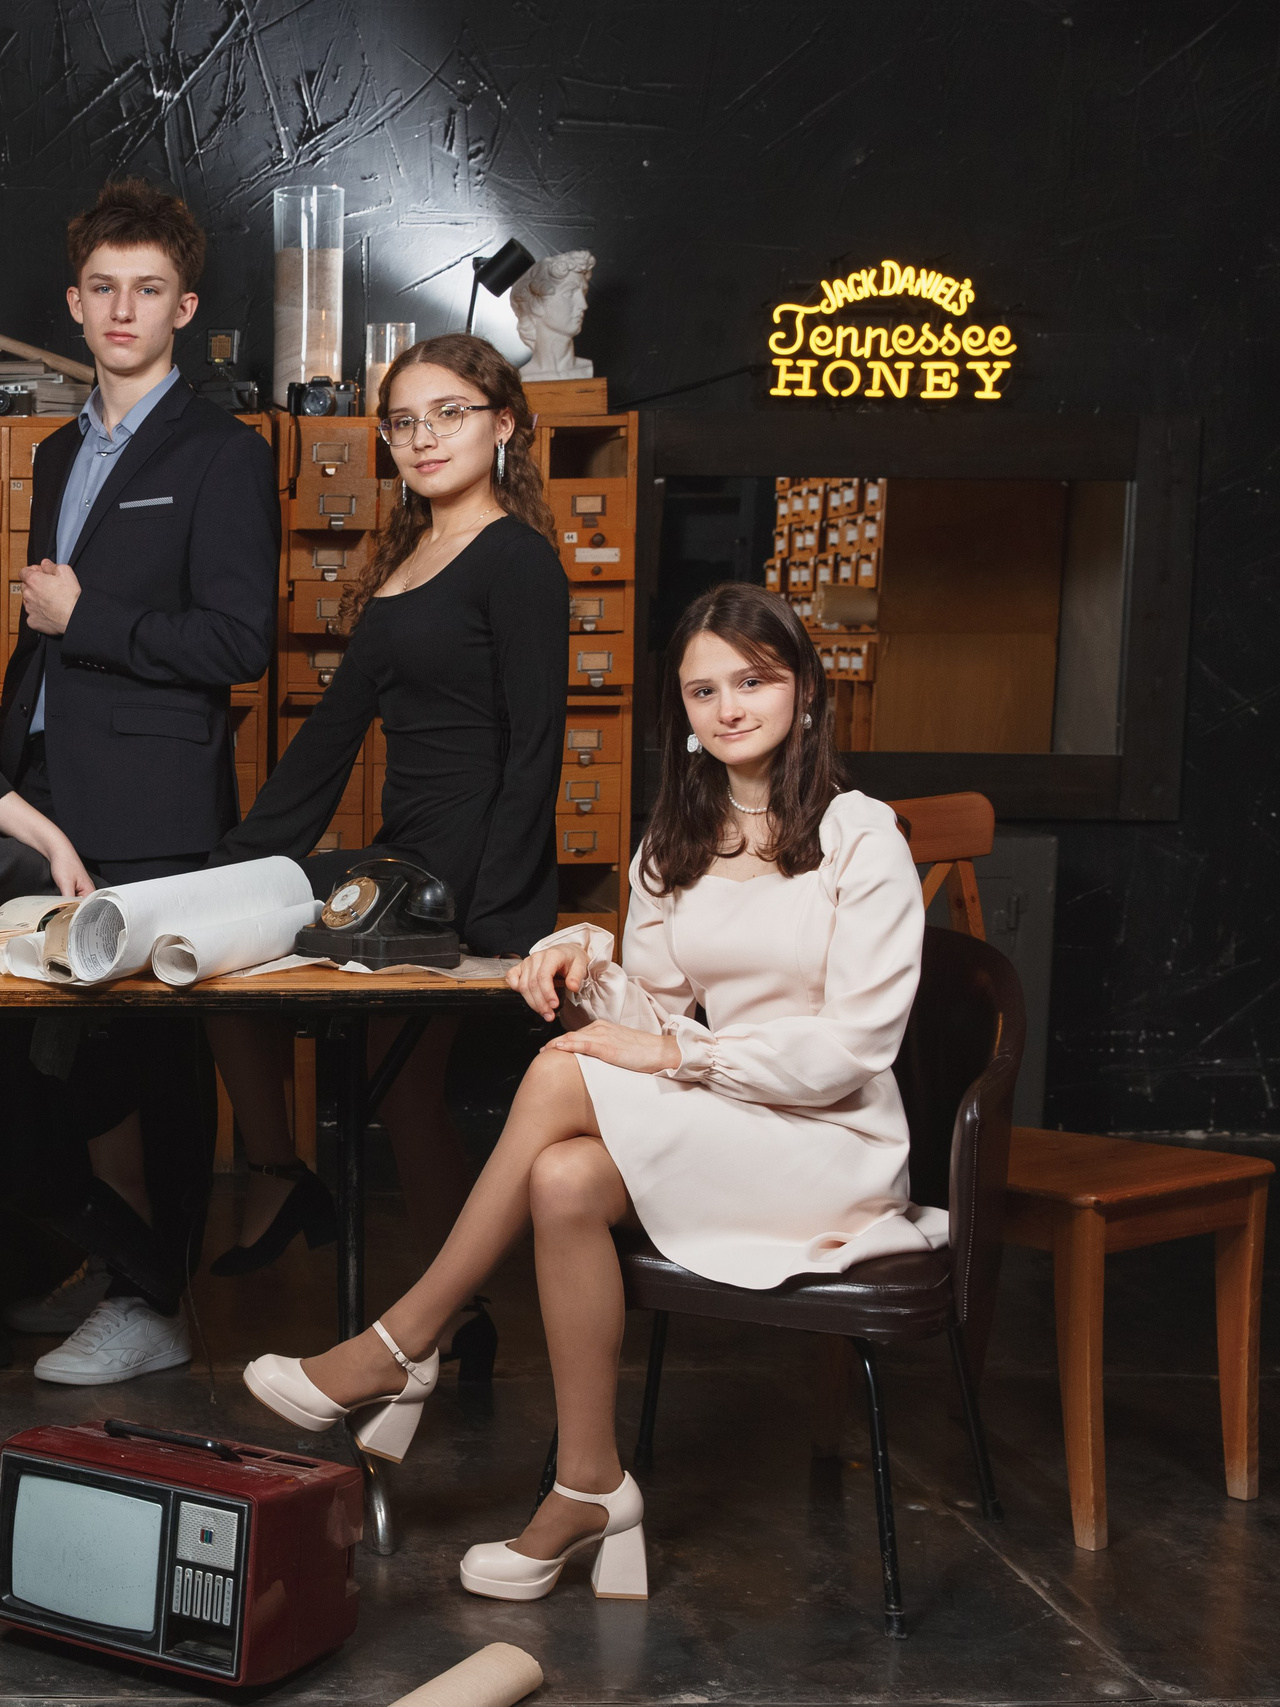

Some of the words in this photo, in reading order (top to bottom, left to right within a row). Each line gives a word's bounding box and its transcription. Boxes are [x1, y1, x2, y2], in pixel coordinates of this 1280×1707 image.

[820, 268, 879, 315] JACK
[879, 260, 975, 316] DANIEL'S
[768, 303, 1018, 359] Tennessee
[770, 358, 1012, 399] HONEY
